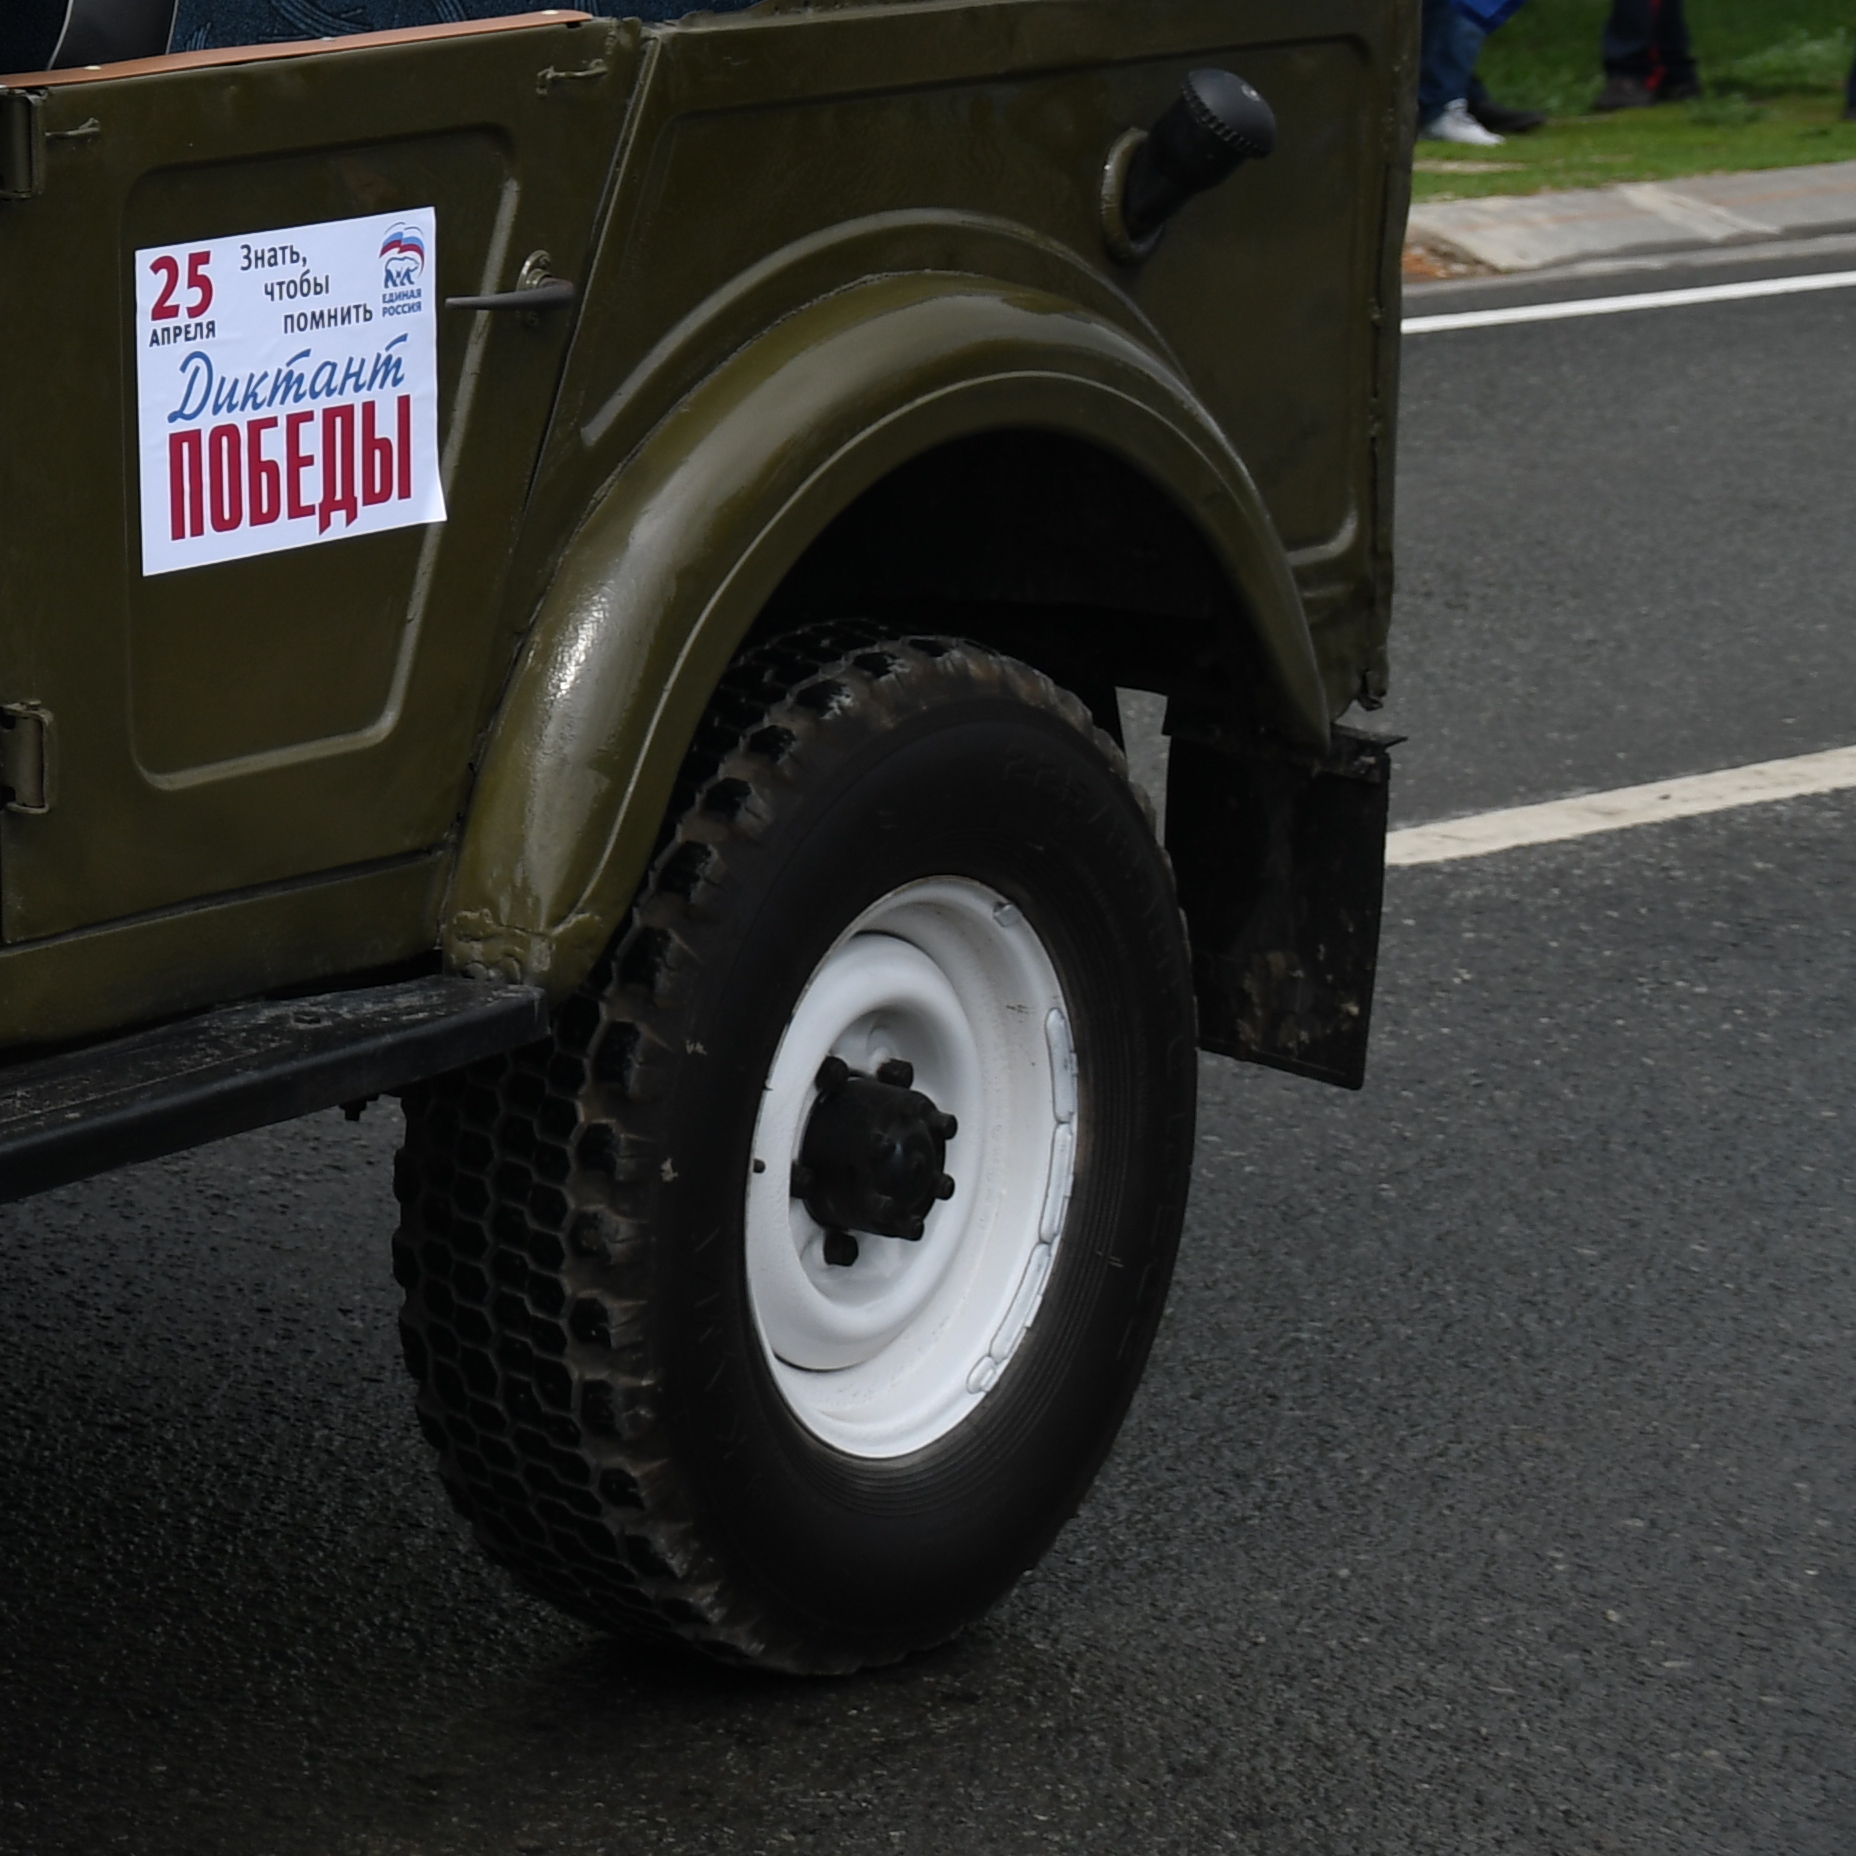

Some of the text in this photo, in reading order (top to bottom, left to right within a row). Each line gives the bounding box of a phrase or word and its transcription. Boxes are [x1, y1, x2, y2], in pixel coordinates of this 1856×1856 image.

[240, 243, 308, 271] Знать,
[149, 250, 214, 321] 25
[264, 269, 330, 302] чтобы
[382, 288, 422, 304] ЕДИНАЯ
[283, 302, 373, 334] помнить
[382, 301, 422, 318] РОССИЯ
[149, 320, 216, 347] АПРЕЛЯ
[167, 332, 409, 424] Диктант
[168, 393, 412, 542] ПОБЕДЫ
